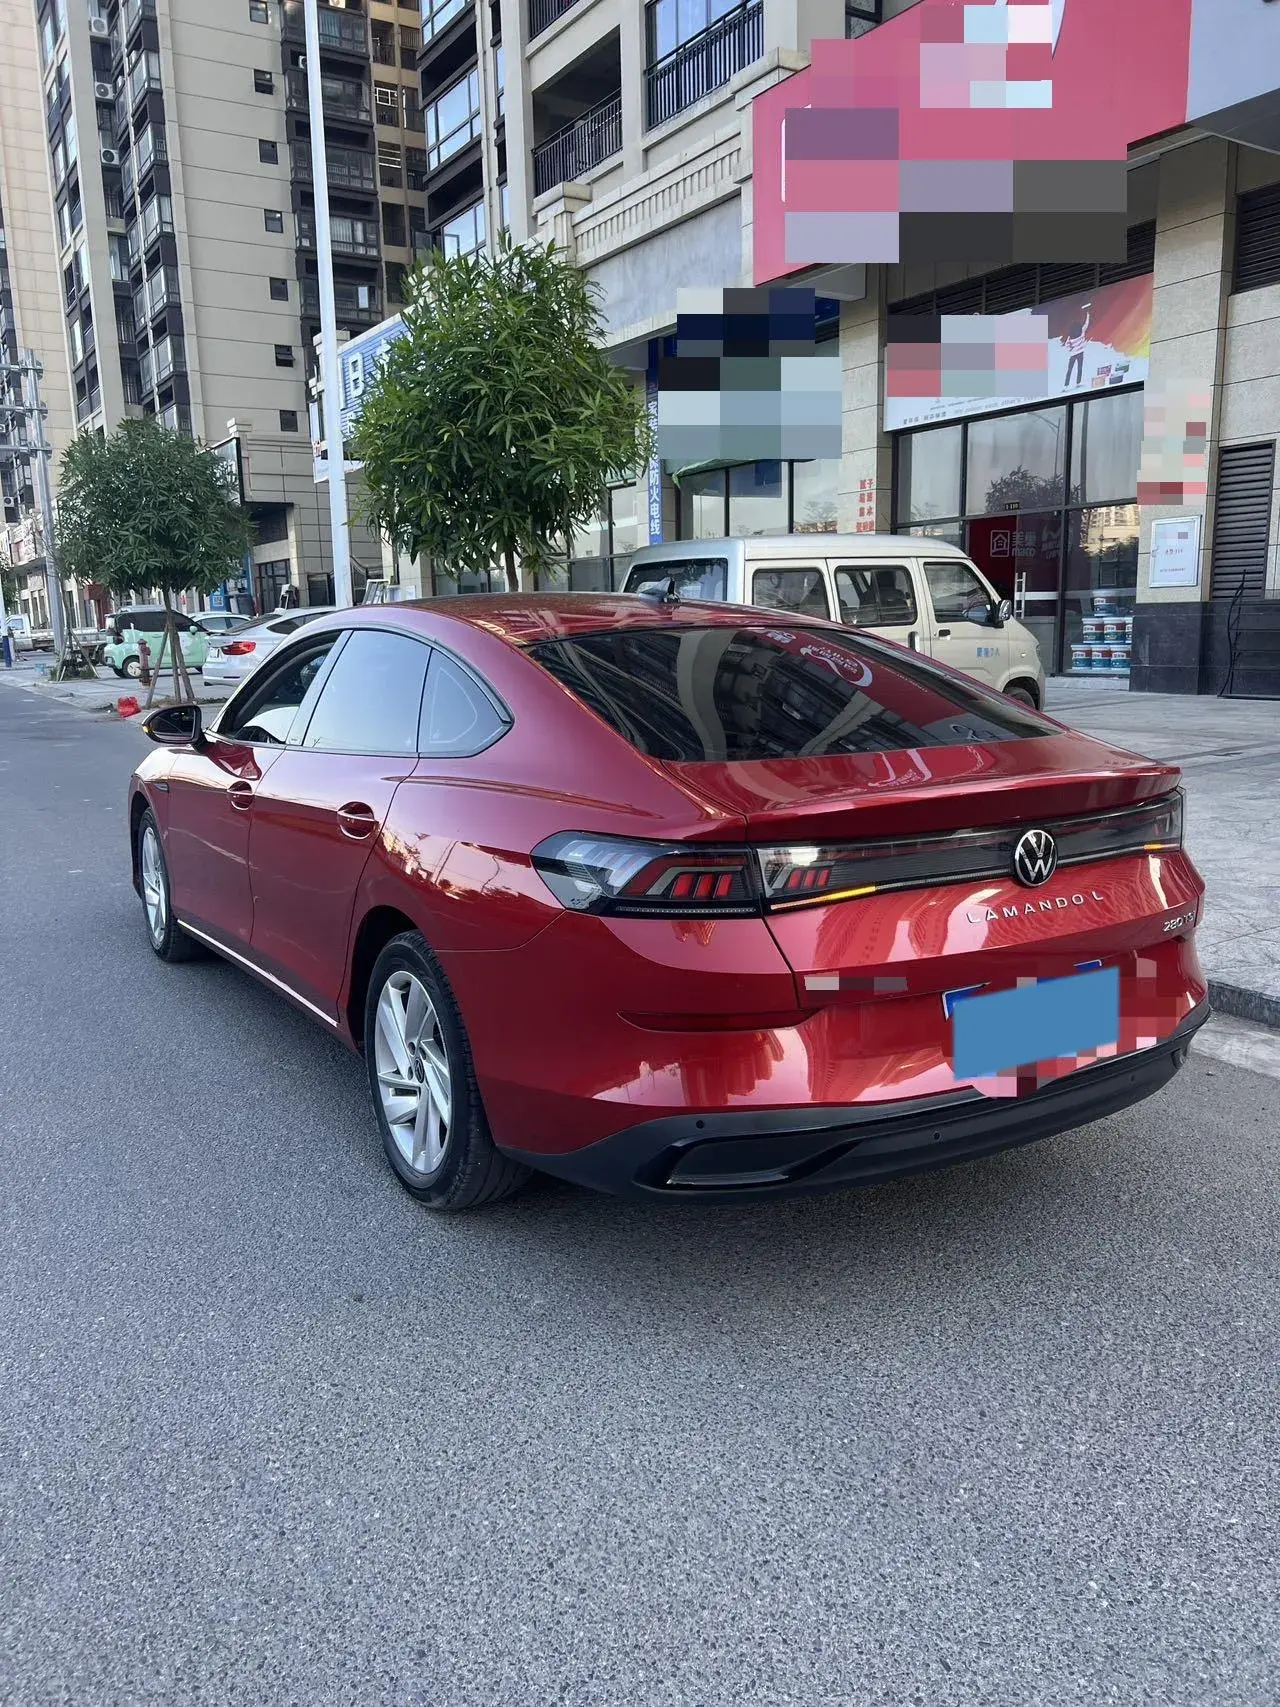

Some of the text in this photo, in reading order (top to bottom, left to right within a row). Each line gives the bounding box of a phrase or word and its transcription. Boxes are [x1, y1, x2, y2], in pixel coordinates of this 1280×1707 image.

[966, 890, 1105, 923] LAMANDO L
[1162, 917, 1183, 932] 280
